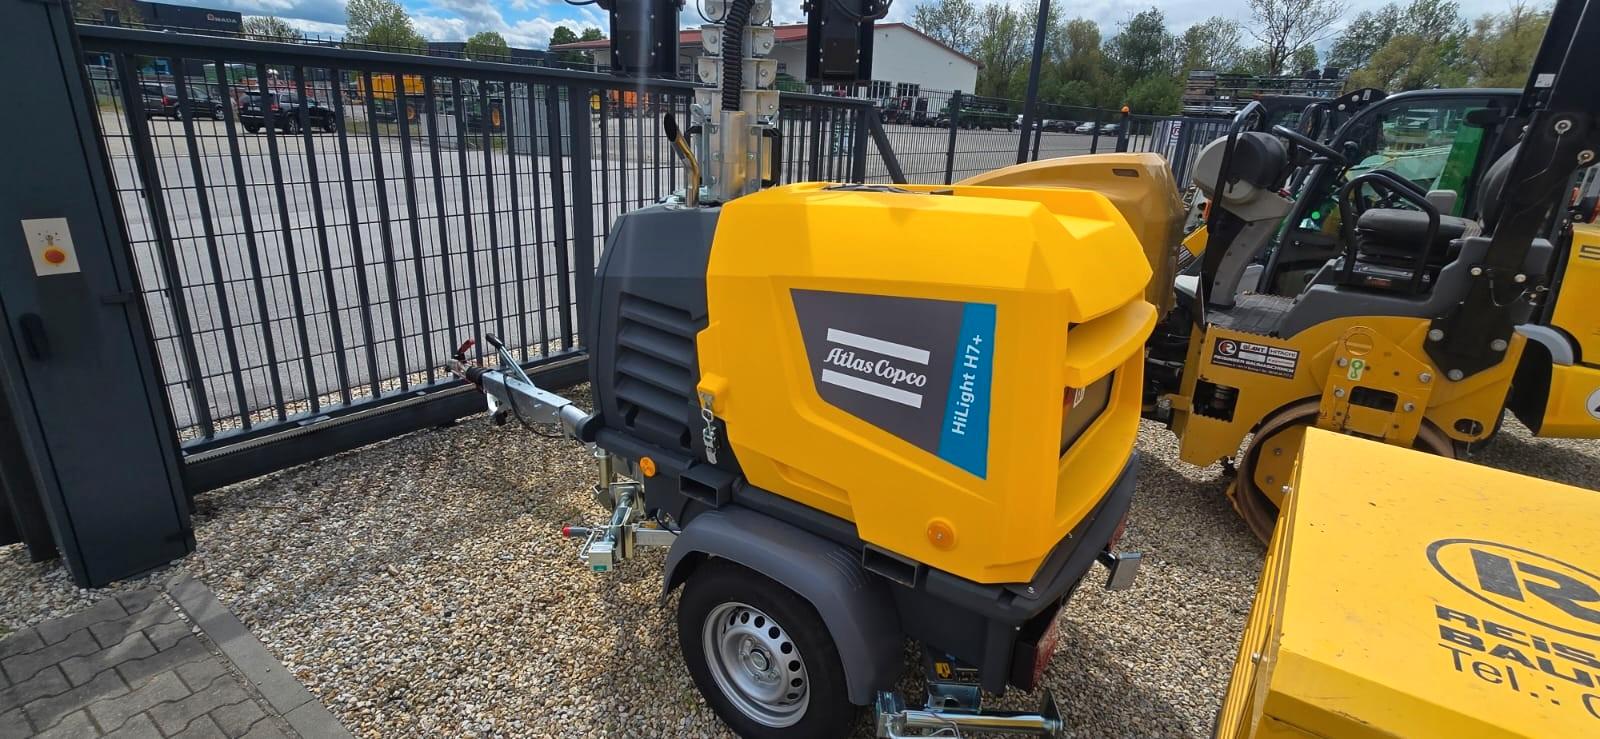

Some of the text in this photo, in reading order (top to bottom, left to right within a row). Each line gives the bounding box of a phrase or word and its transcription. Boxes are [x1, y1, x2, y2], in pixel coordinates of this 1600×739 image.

[824, 347, 927, 388] Atlas Copco
[951, 334, 983, 435] HiLight H7+
[1438, 643, 1561, 706] Tel.:
[1439, 624, 1600, 688] BAU
